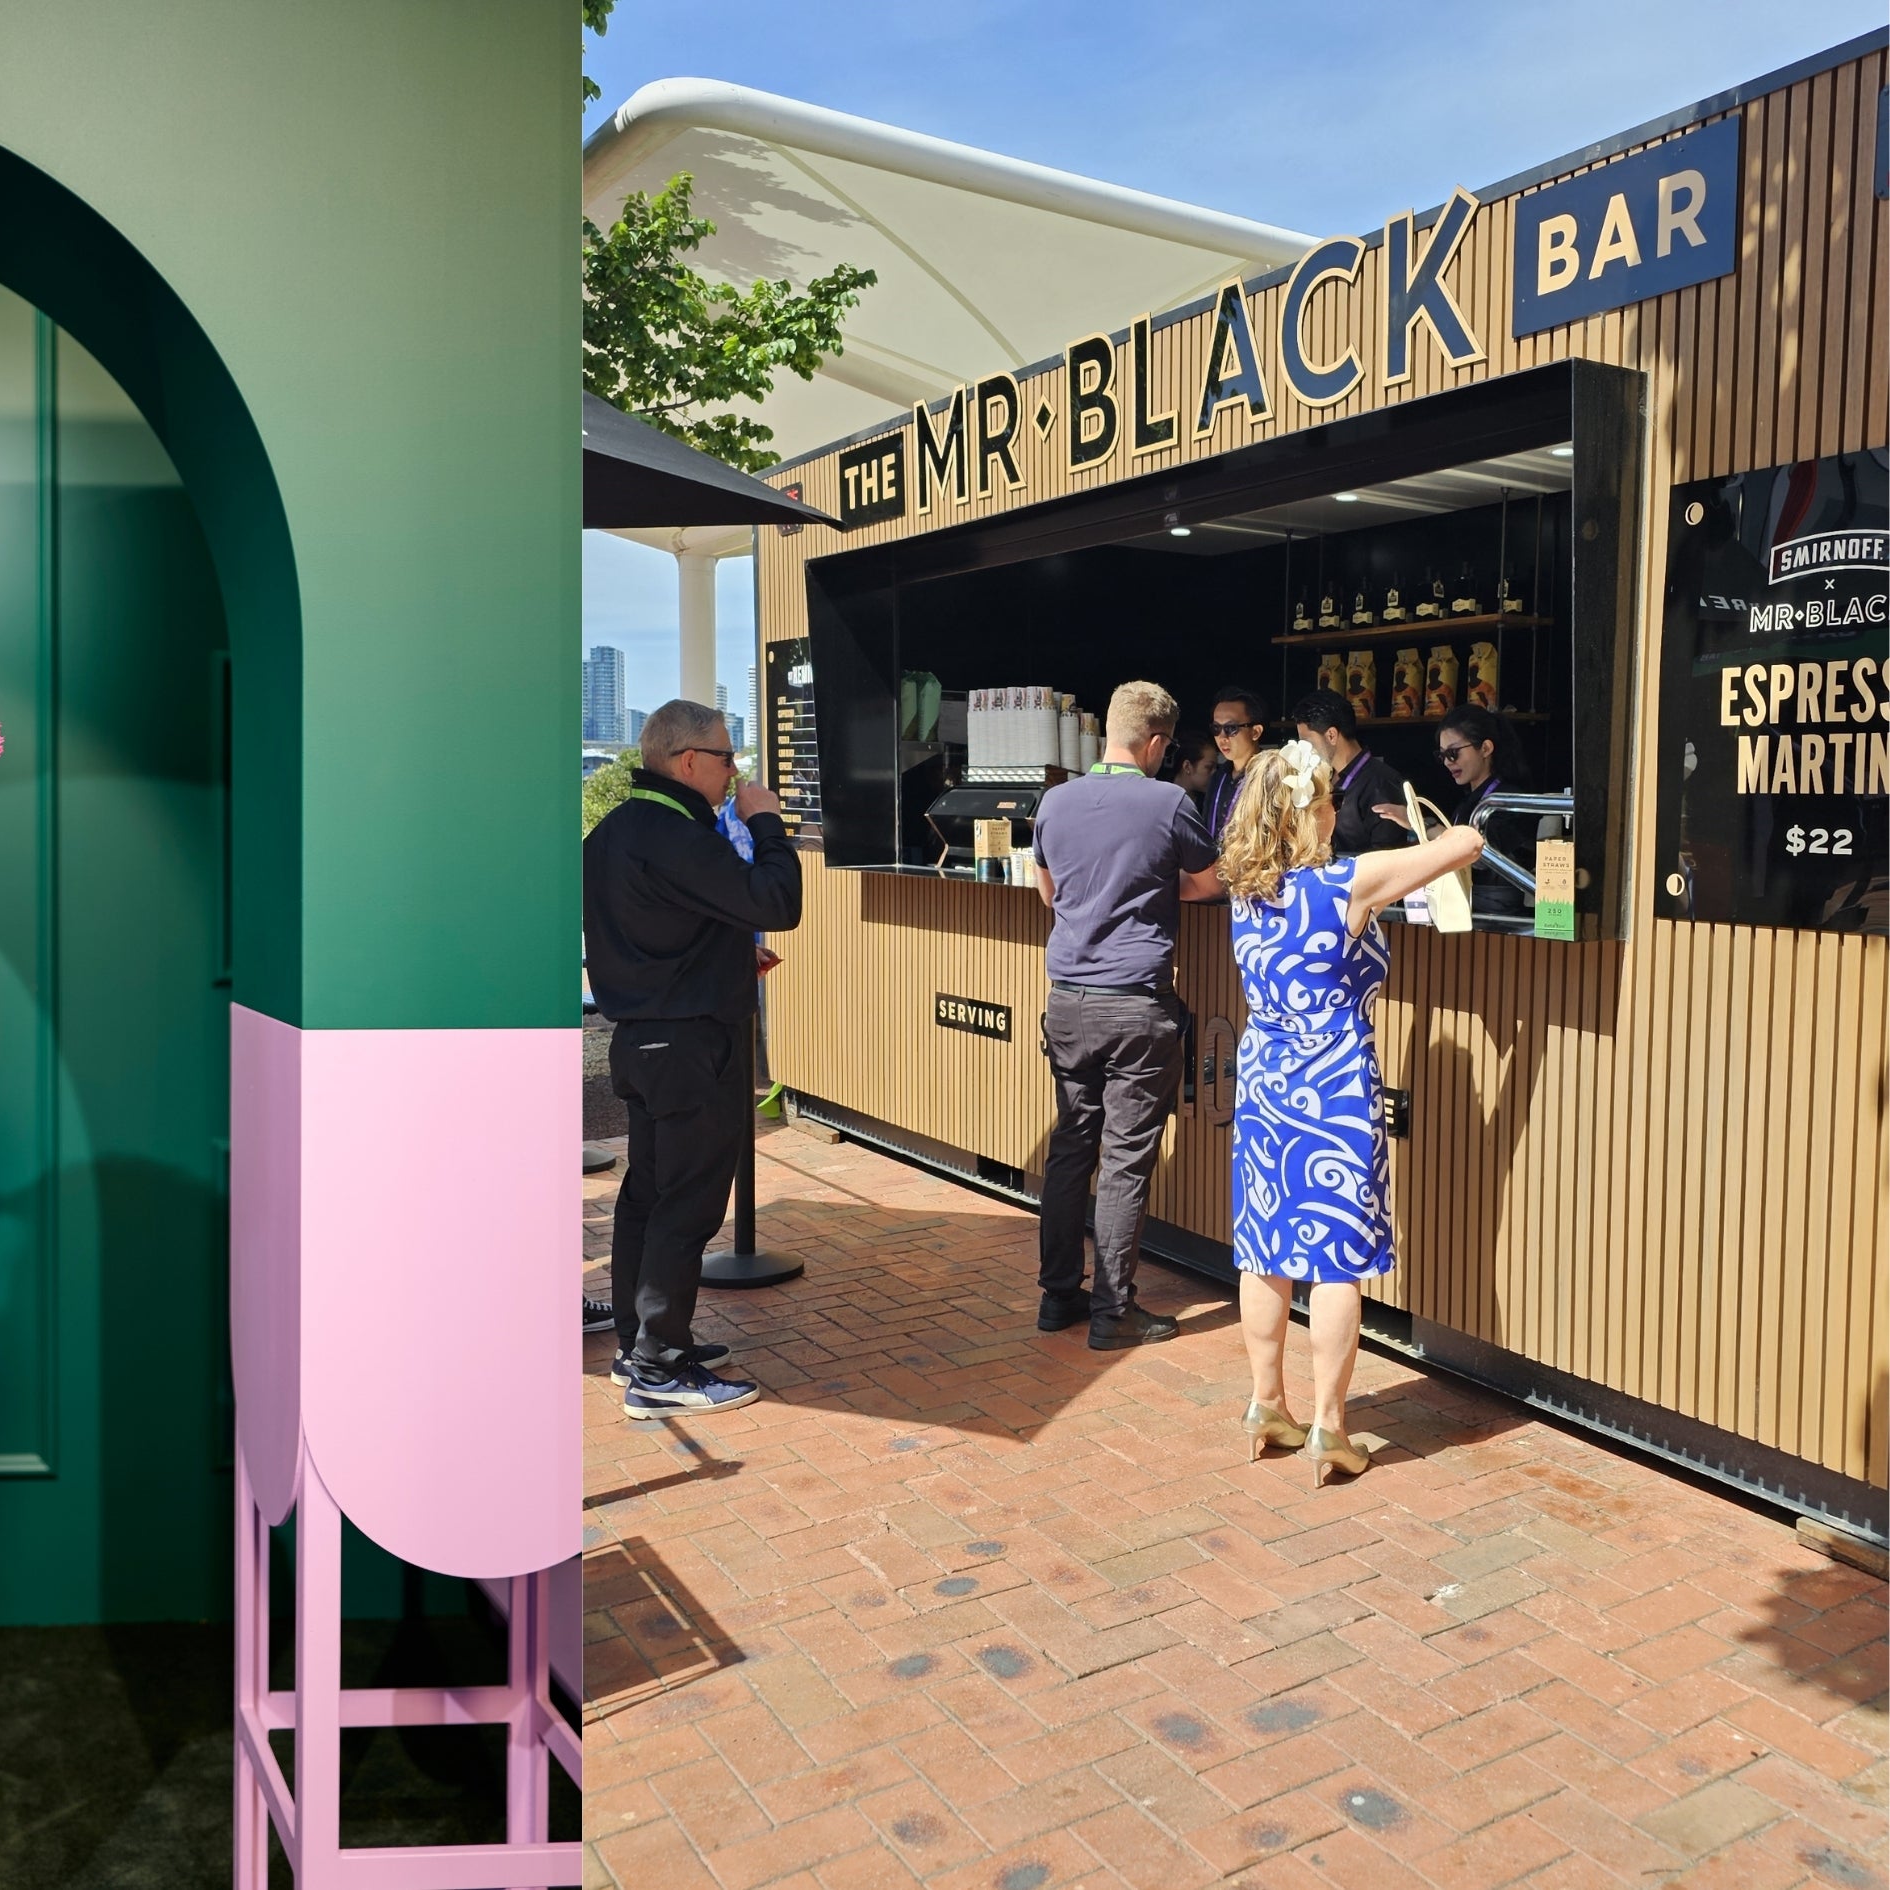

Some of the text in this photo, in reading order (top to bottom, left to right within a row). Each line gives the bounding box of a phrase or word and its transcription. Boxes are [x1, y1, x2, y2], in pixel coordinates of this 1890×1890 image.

[844, 168, 1708, 515] THE MR BLACK BAR
[1805, 594, 1889, 628] BLAC
[1785, 824, 1853, 857] $22
[939, 999, 1006, 1032] SERVING
